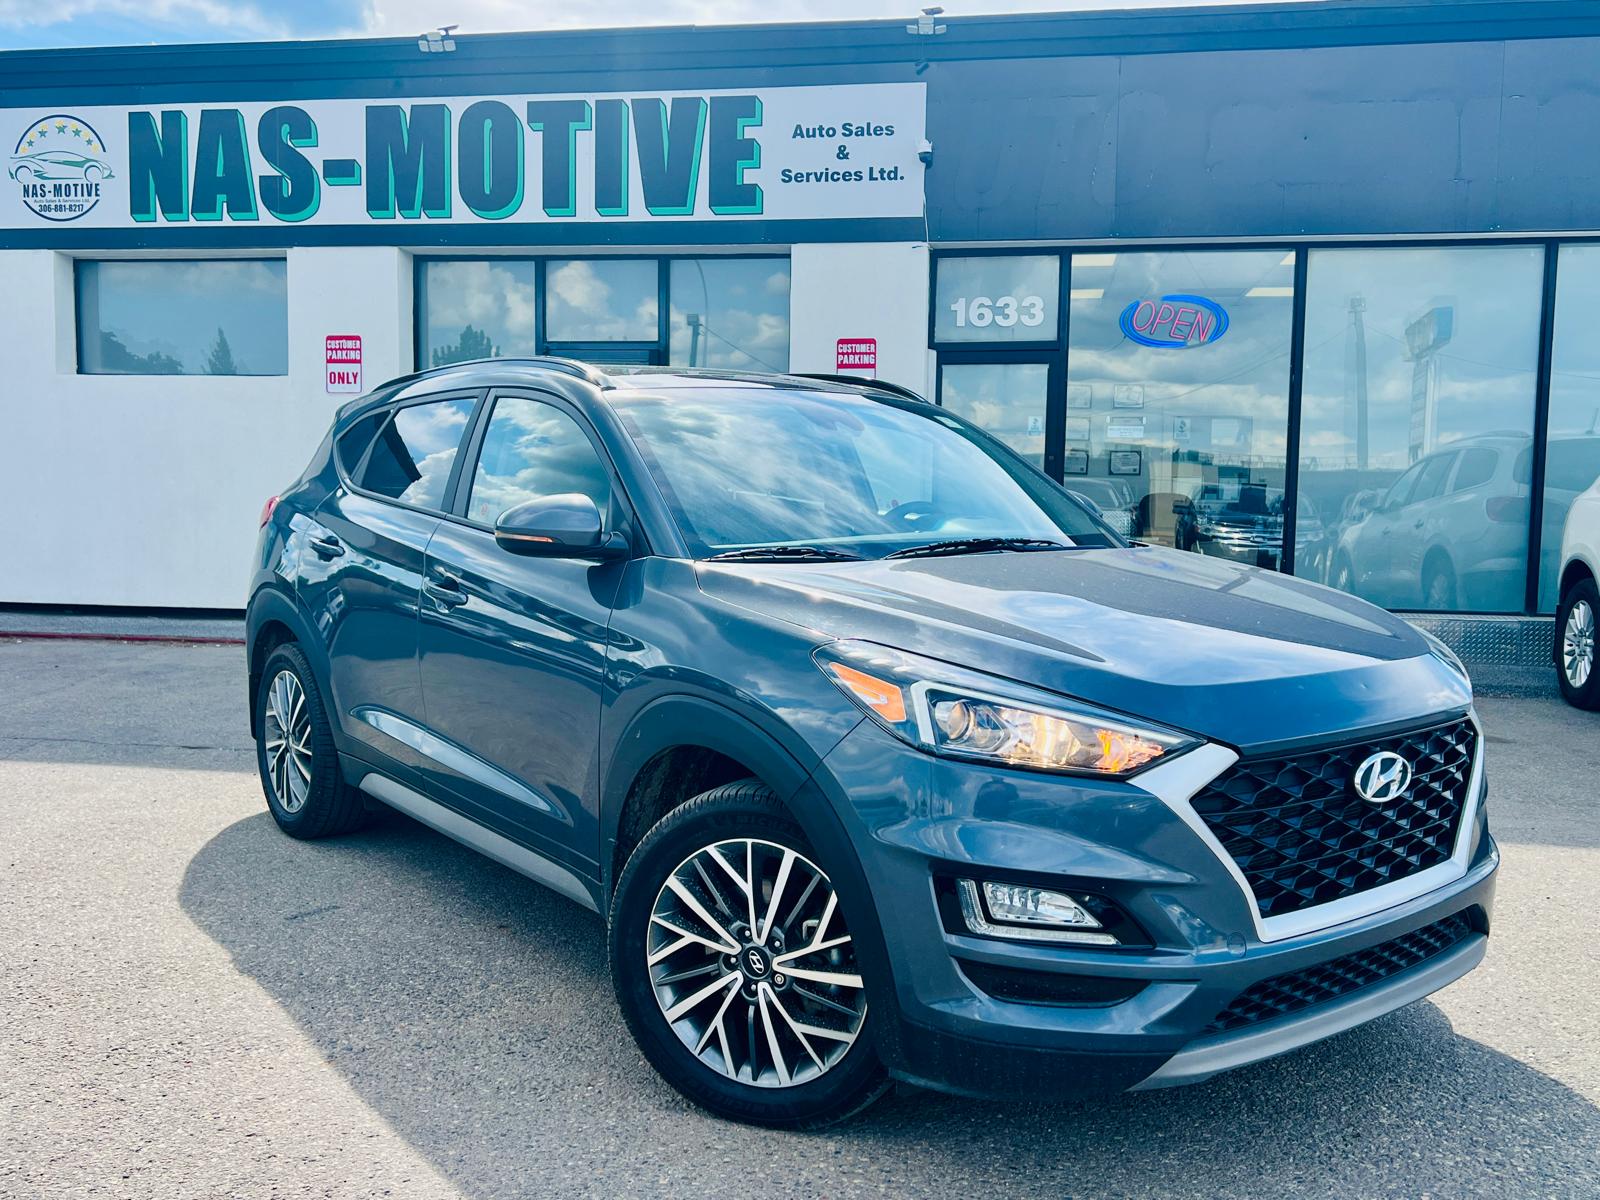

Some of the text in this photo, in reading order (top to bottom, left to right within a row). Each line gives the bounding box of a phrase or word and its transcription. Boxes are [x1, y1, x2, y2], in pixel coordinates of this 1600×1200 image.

[792, 122, 895, 139] Auto Sales
[128, 95, 764, 223] NAS-MOTIVE
[836, 145, 850, 160] &
[781, 166, 905, 183] Services Ltd.
[23, 183, 100, 198] NAS-MOTIVE
[950, 296, 1045, 327] 1633
[1132, 301, 1214, 342] OPEN
[327, 340, 360, 349] CUSTOMER
[838, 343, 876, 353] CUSTOMER
[327, 350, 360, 360] PARKING
[838, 354, 876, 365] PARKING
[329, 371, 358, 384] ONLY
